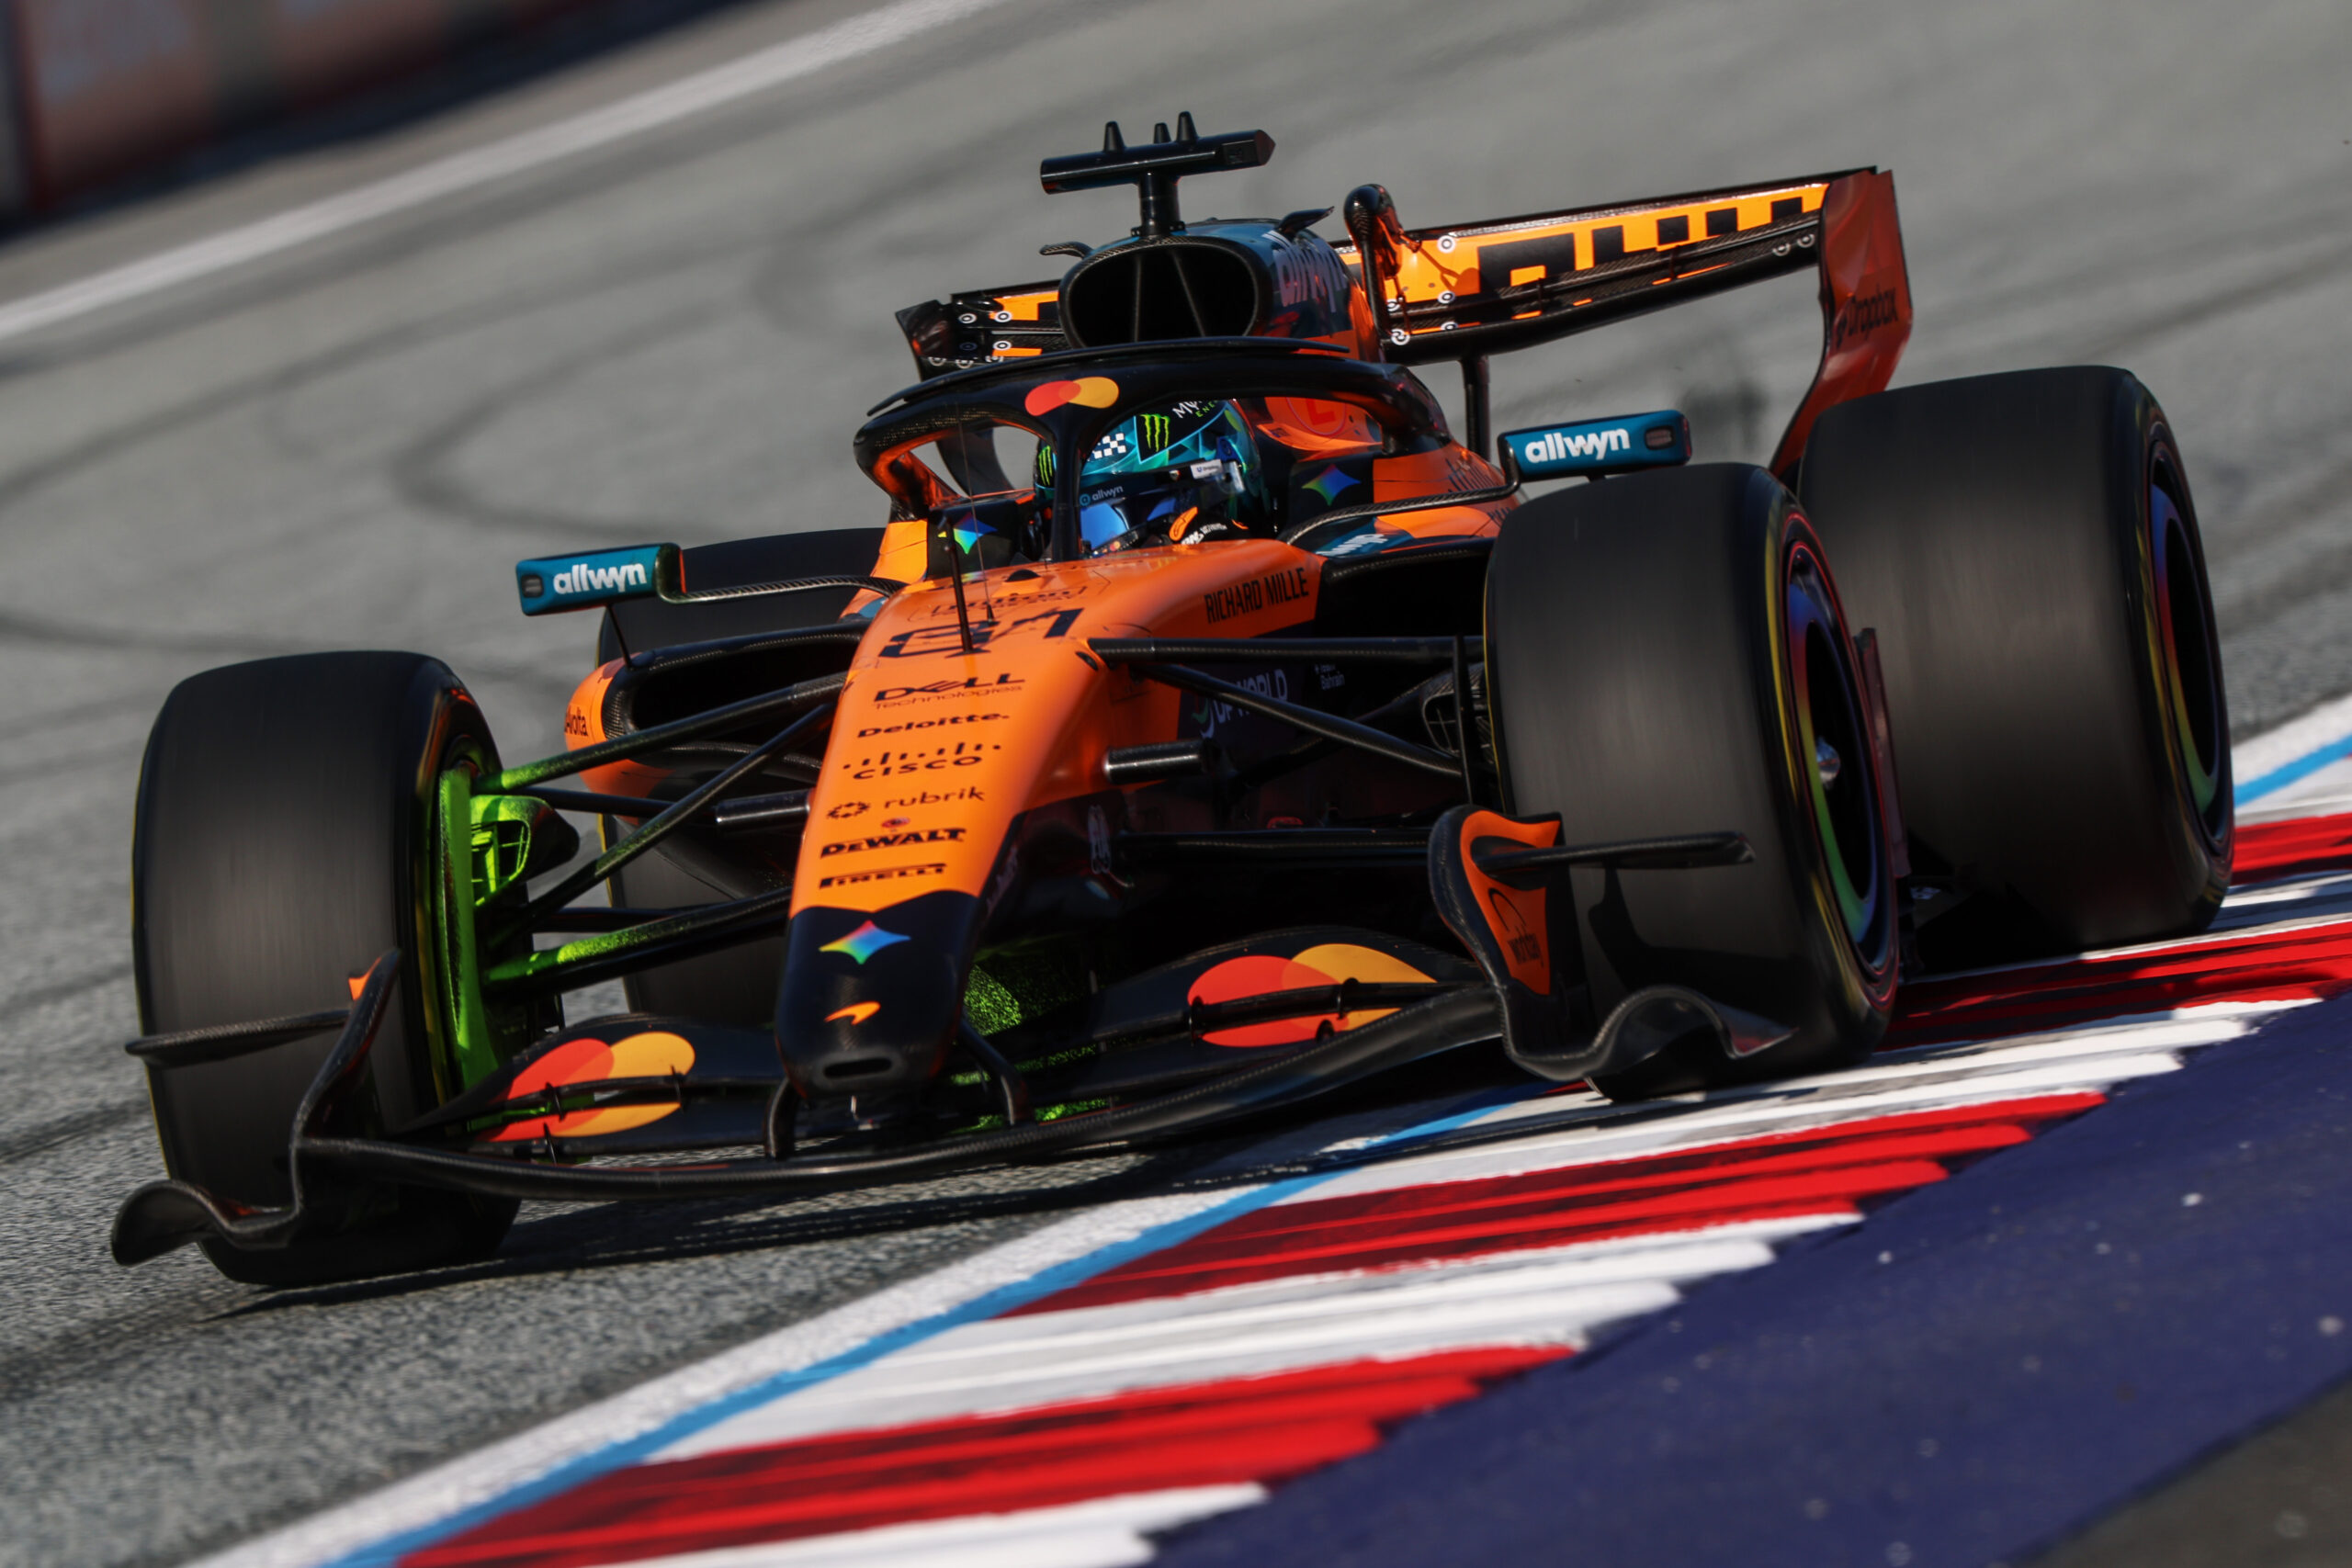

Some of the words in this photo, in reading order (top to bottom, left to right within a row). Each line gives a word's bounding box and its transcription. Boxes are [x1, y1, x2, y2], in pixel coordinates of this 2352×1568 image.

[1525, 427, 1630, 461] allwyn
[1091, 486, 1124, 501] allwyn
[553, 563, 648, 593] allwyn
[1204, 580, 1262, 625] RICHARD
[1266, 567, 1309, 609] MILLE
[874, 673, 1025, 703] DELL
[876, 685, 1023, 709] Technologies
[884, 786, 986, 809] rubrik
